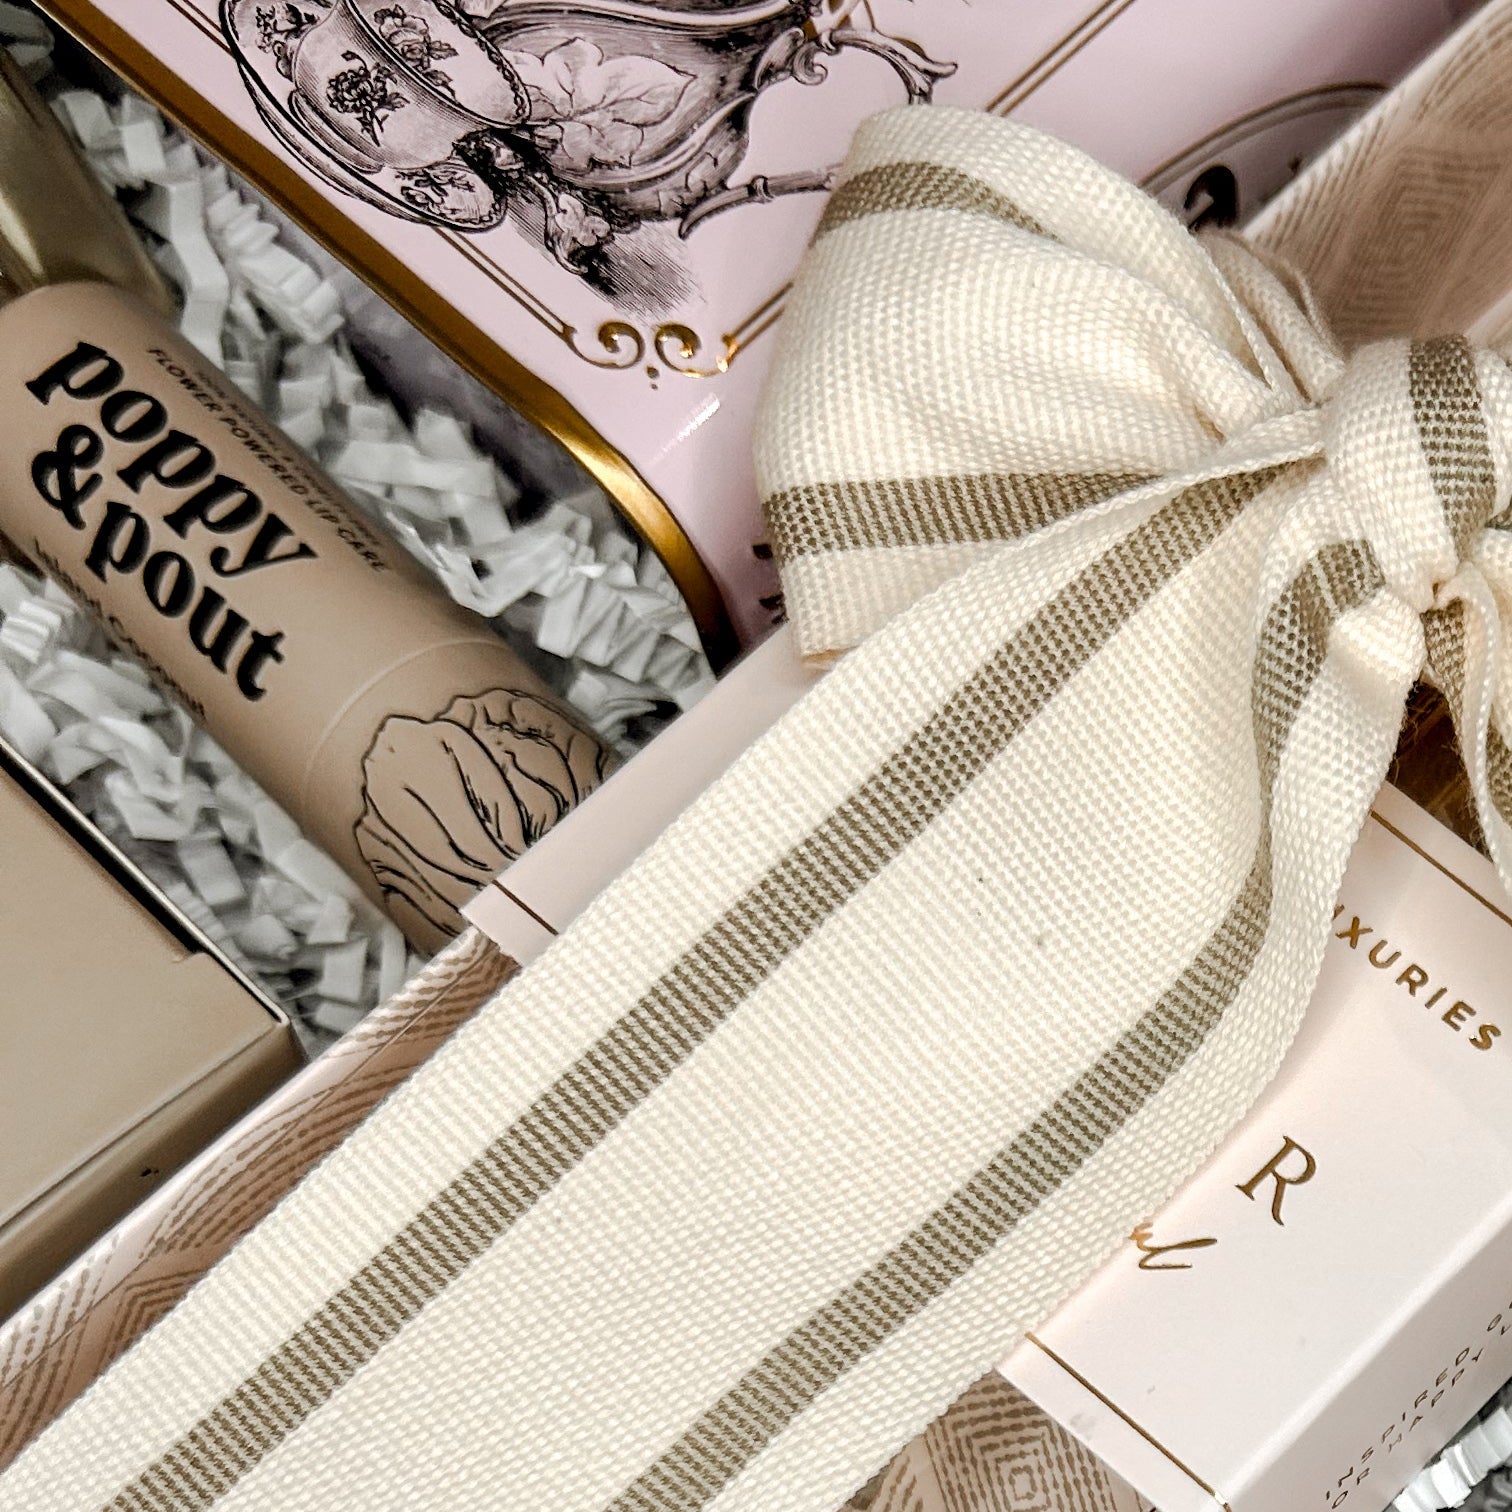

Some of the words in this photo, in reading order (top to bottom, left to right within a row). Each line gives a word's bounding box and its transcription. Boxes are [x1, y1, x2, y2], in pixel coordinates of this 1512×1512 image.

[25, 341, 318, 578] poppy
[147, 348, 223, 413] FLOWER
[219, 416, 308, 497] POWERED
[1331, 904, 1502, 1051] XURIES
[1326, 1347, 1470, 1500] INSPIRED
[1388, 1348, 1484, 1453] HAPPY
